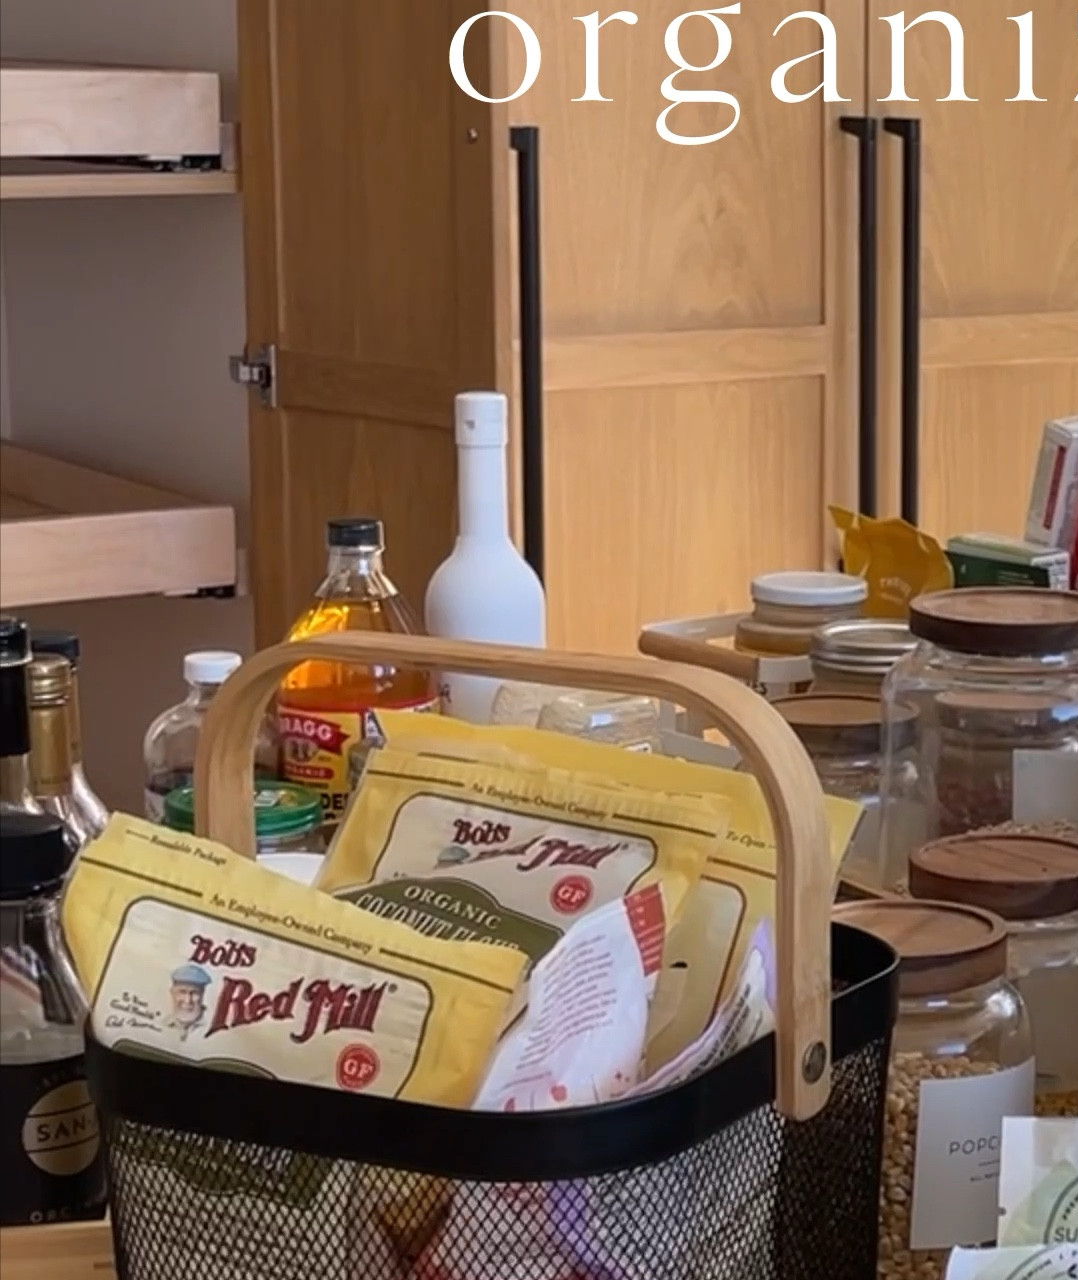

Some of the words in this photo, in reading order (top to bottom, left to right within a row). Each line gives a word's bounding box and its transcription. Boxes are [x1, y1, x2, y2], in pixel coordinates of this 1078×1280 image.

[452, 818, 512, 847] Bob's
[404, 884, 502, 930] ORGANIC
[558, 885, 584, 904] GF
[209, 892, 226, 908] An
[323, 926, 373, 956] Company
[189, 934, 258, 969] Bob's
[204, 976, 306, 1039] Red
[290, 977, 388, 1044] Mill
[344, 1057, 374, 1078] GF
[949, 1135, 1000, 1155] POPC
